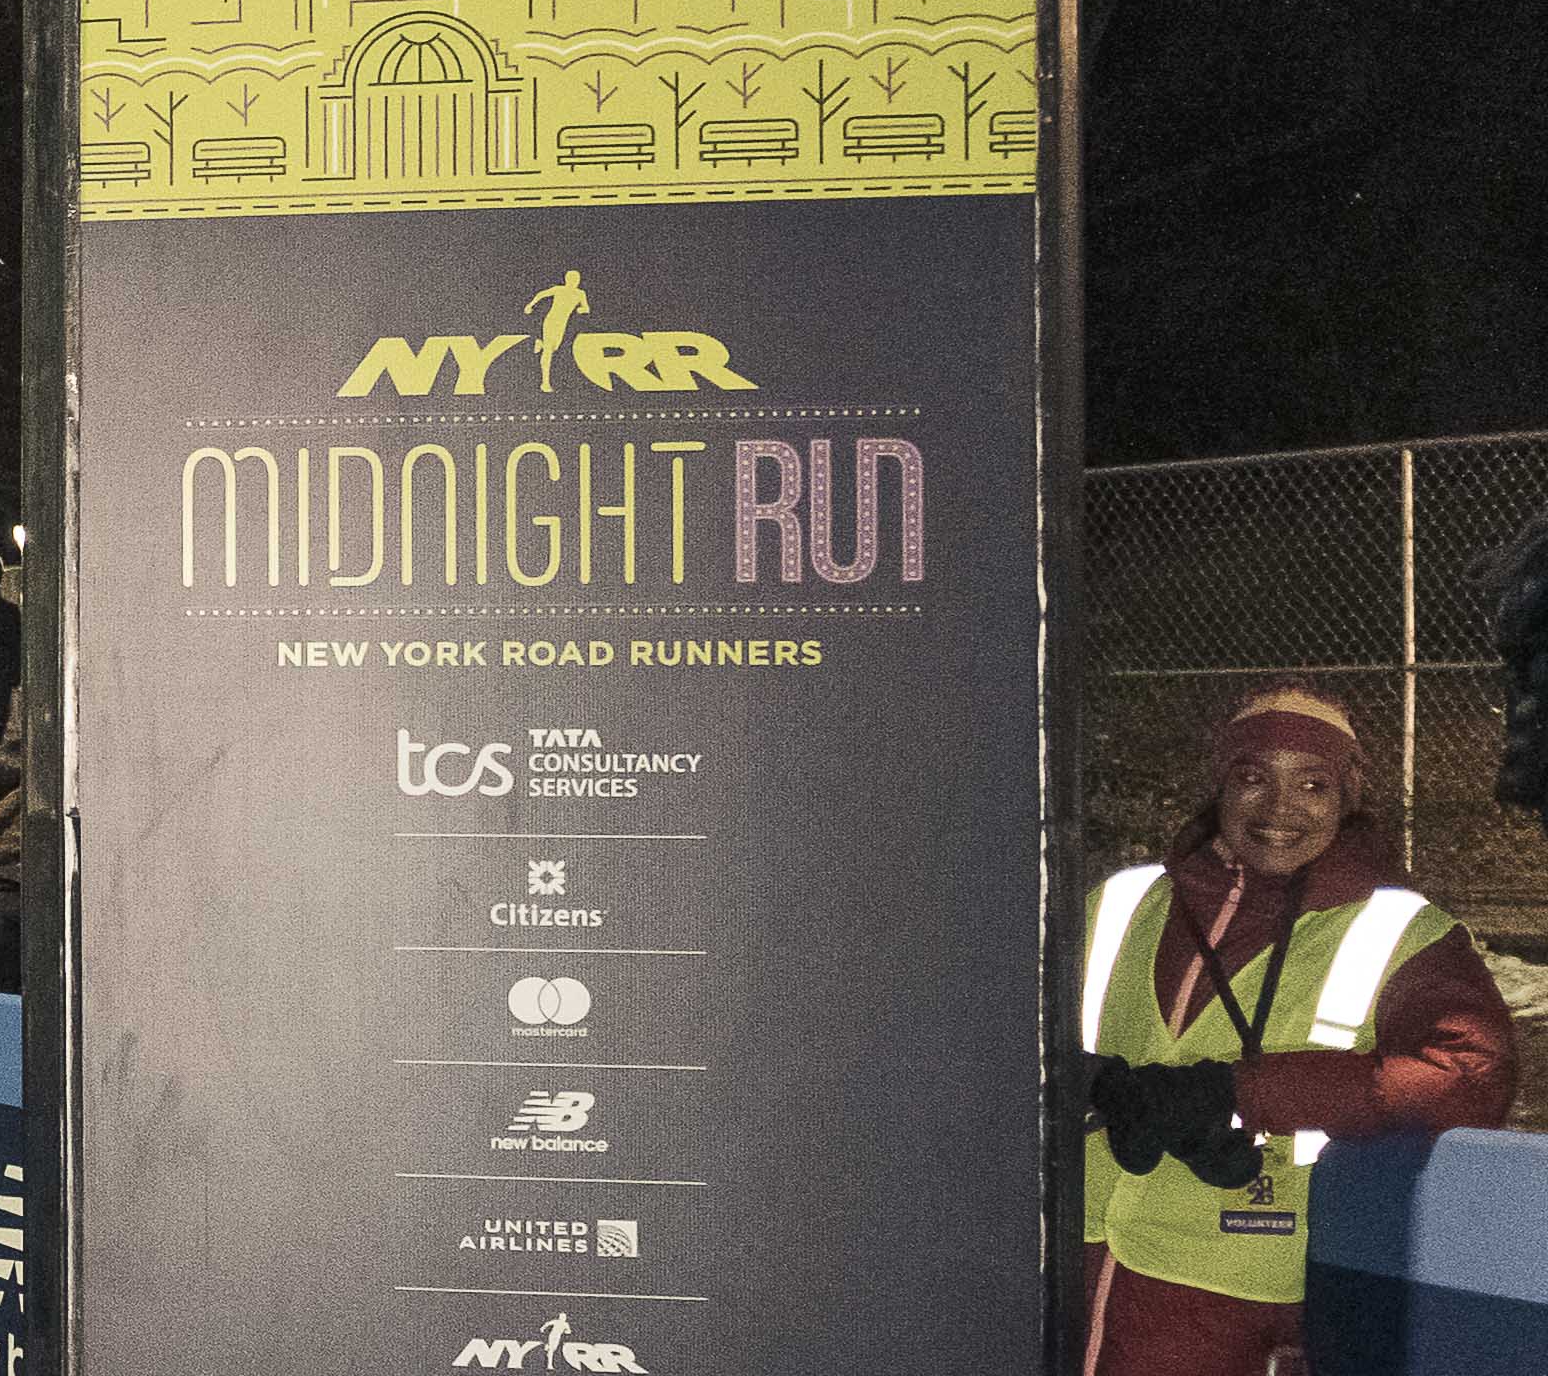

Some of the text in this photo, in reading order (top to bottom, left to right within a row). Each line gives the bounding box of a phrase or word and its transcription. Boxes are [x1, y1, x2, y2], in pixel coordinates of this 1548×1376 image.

[180, 438, 926, 589] MIDNIGHT RUN
[276, 639, 824, 668] NEW YORK ROAD RUNNERS
[528, 728, 603, 748] TATA
[397, 728, 514, 797] tcs
[528, 753, 702, 773] CONSULTANCY
[528, 777, 639, 798] SERVICES
[490, 903, 604, 927] Citizens
[511, 1026, 589, 1038] mastercard
[490, 1135, 609, 1153] new balance
[484, 1219, 589, 1237] UNITED
[458, 1236, 589, 1254] AIRLINES
